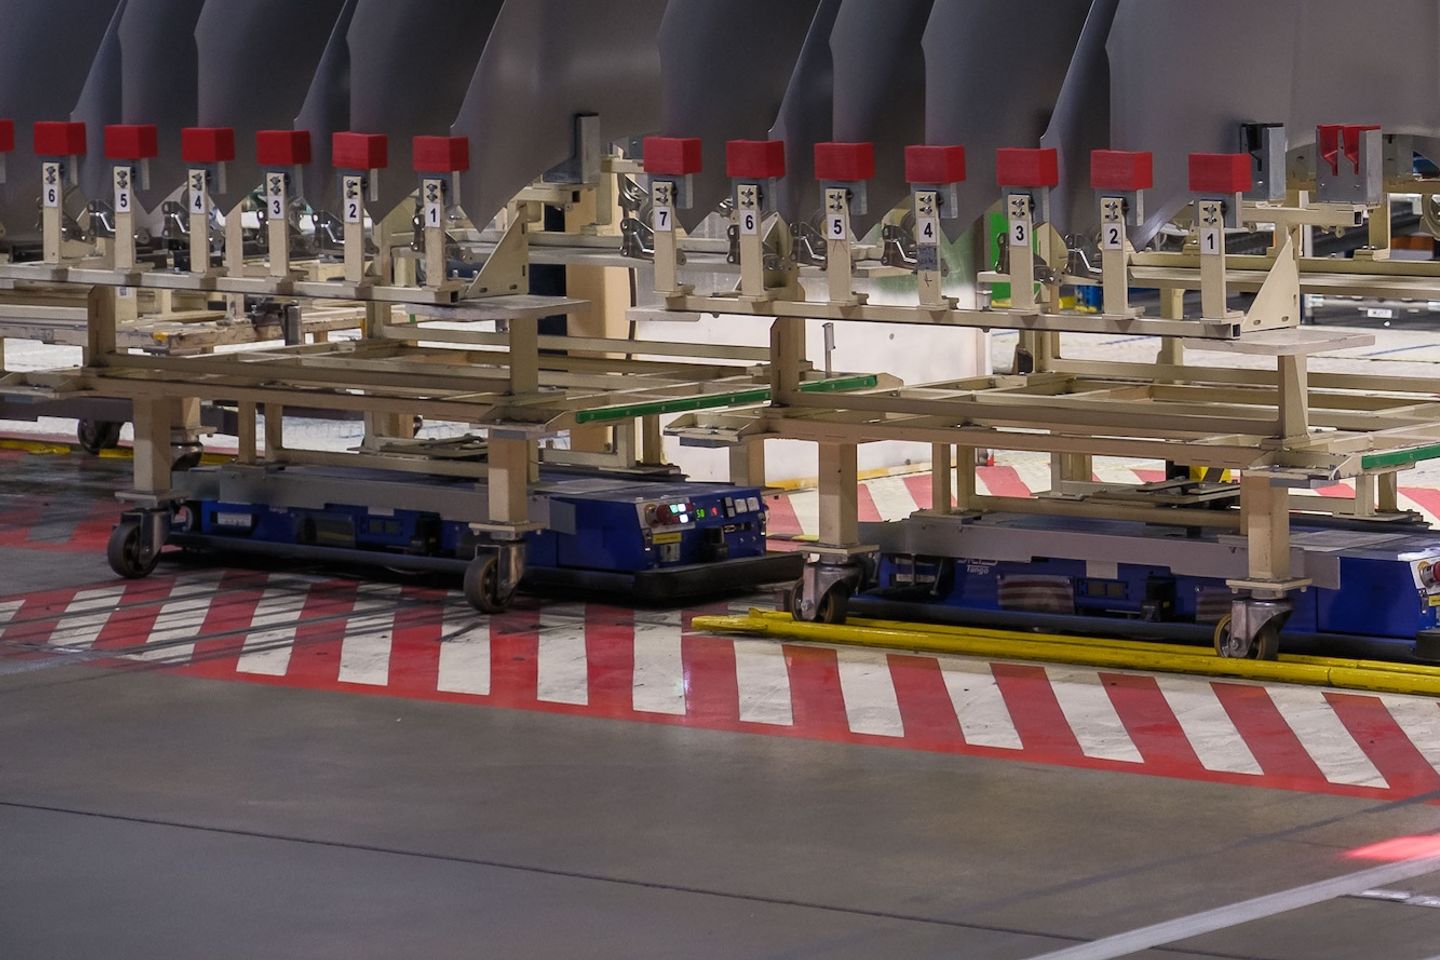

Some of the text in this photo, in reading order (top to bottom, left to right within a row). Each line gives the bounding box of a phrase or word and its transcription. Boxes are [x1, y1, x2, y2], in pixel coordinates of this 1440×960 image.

[48, 189, 55, 203] 6
[120, 193, 128, 208] 5
[195, 195, 202, 210] 4
[273, 200, 280, 214] 3
[349, 203, 357, 218] 2
[430, 208, 436, 223] 1
[659, 211, 668, 226] 7
[746, 214, 754, 230] 6
[833, 219, 842, 235] 5
[924, 222, 933, 238] 4
[1016, 225, 1024, 241] 3
[1109, 228, 1118, 244] 2
[1207, 233, 1215, 251] 1
